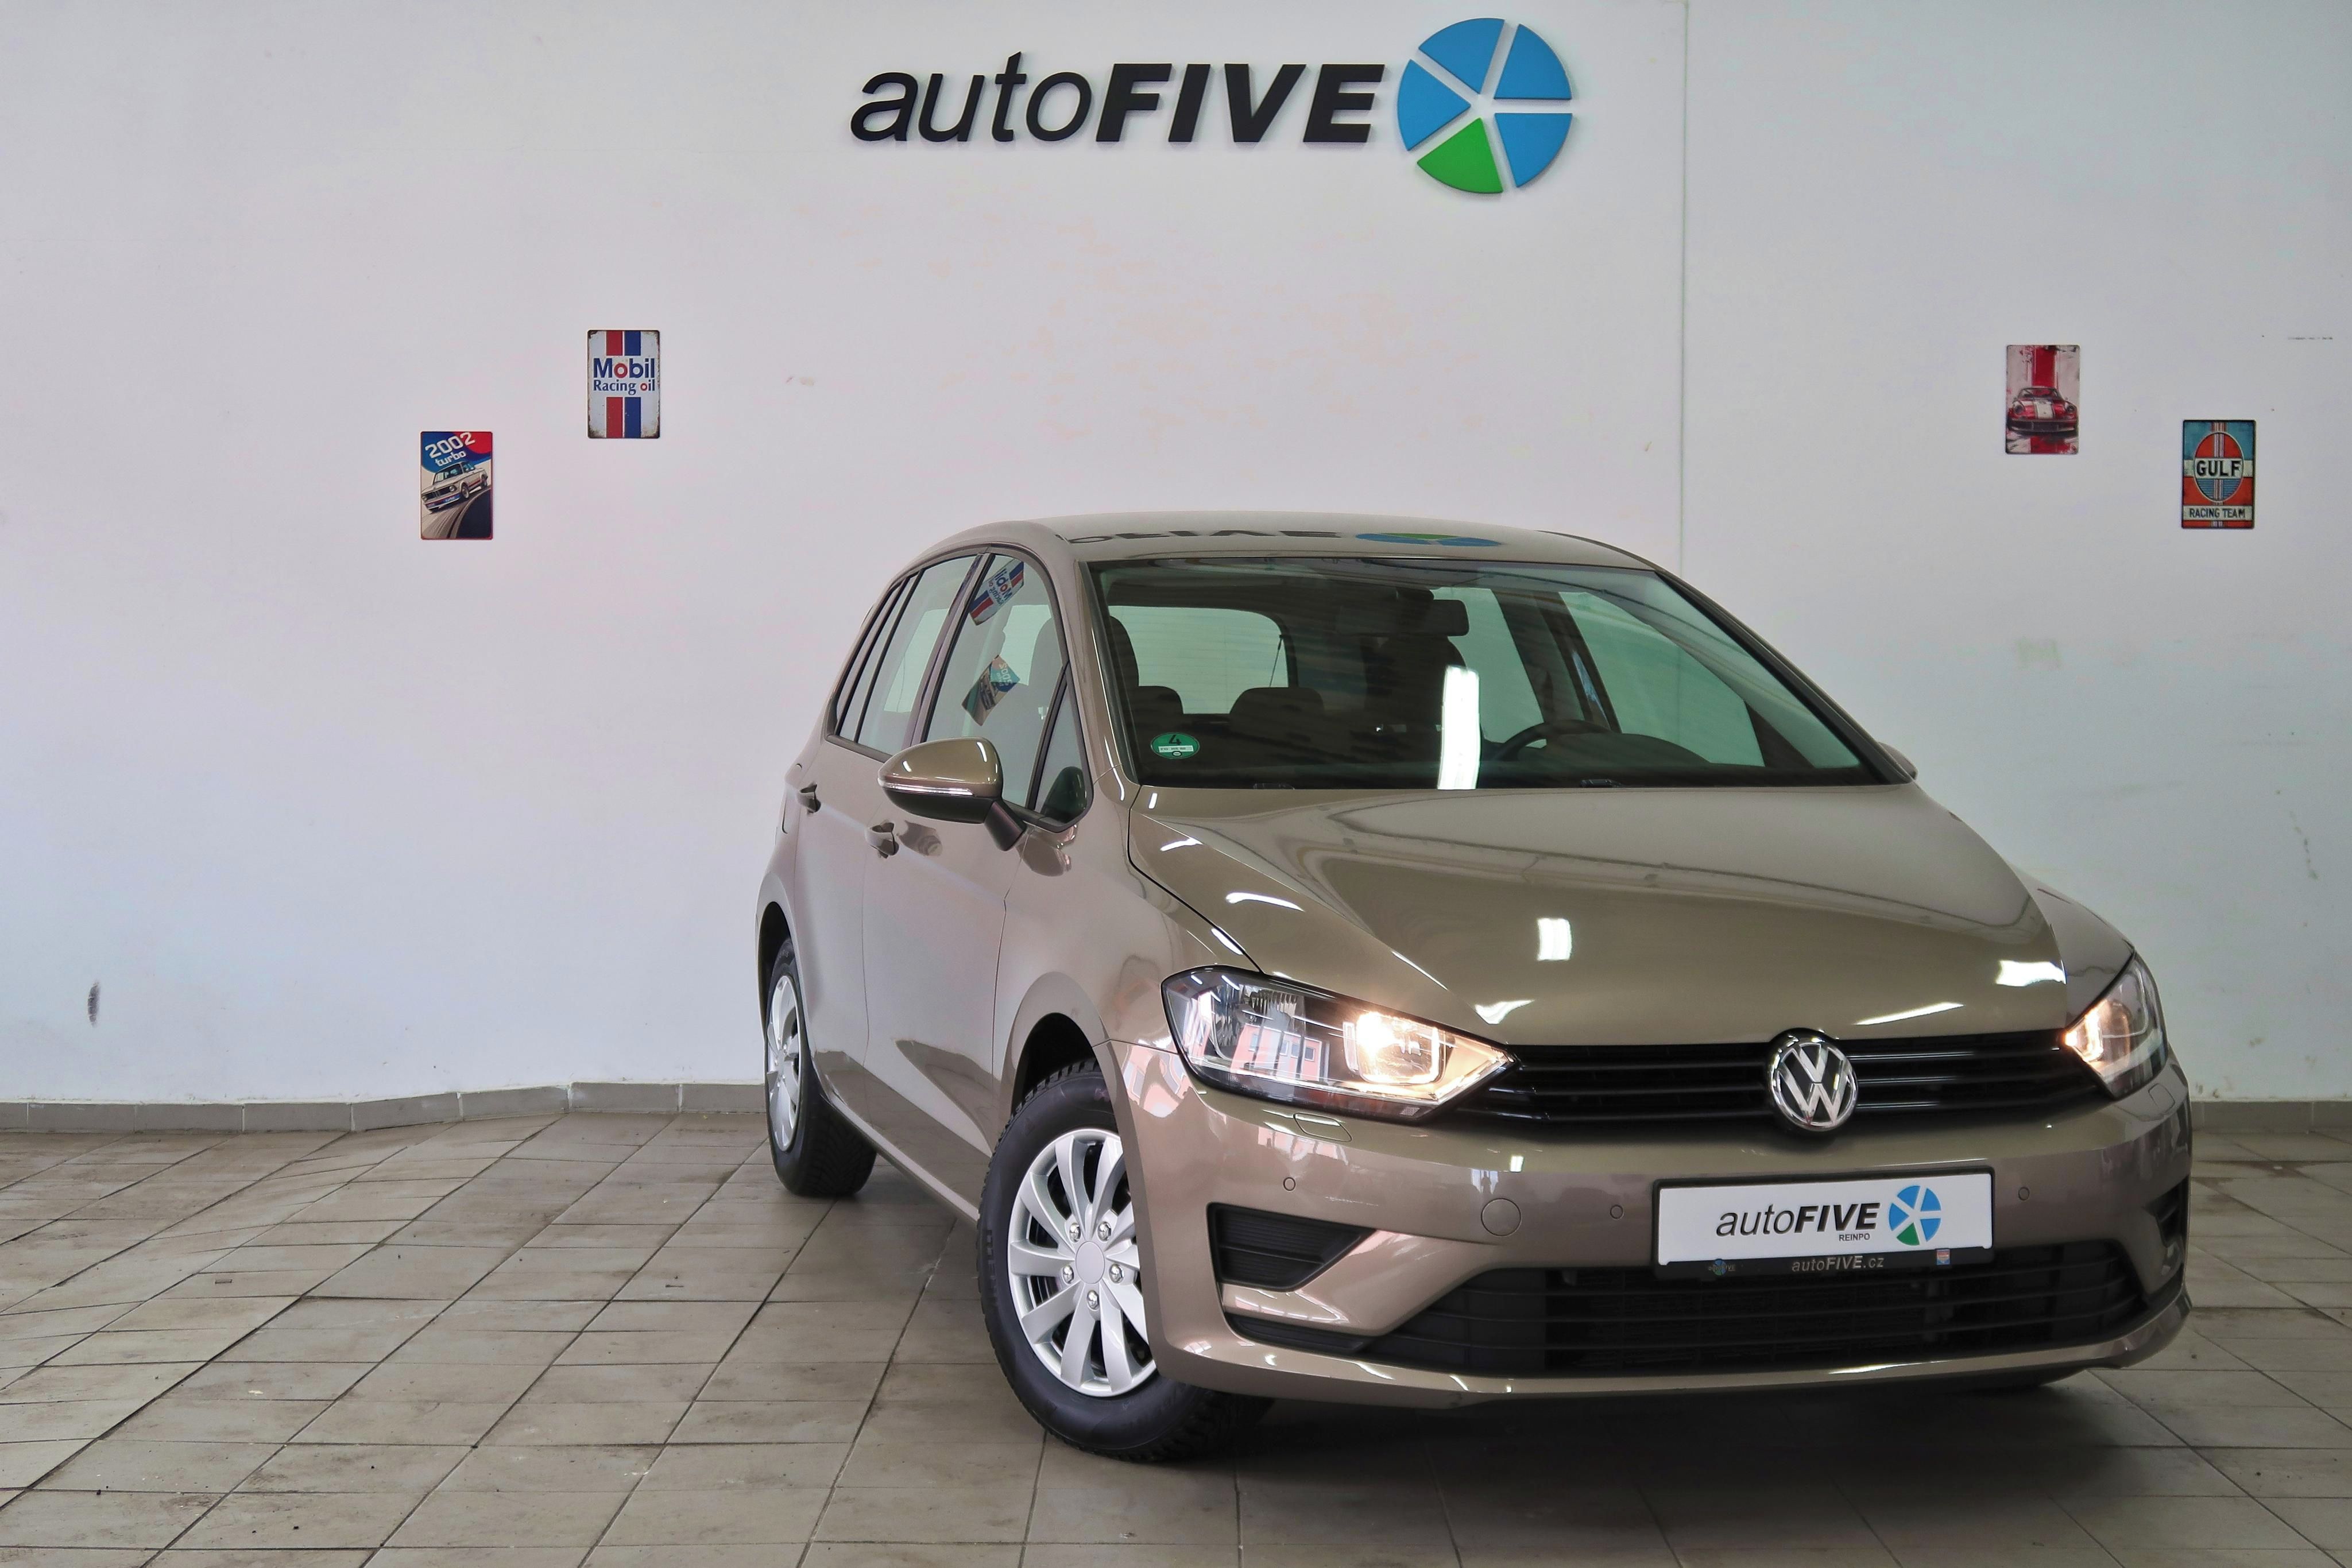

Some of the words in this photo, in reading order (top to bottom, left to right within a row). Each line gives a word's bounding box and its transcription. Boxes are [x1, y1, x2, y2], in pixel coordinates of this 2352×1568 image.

[850, 51, 1385, 143] autoFIVE
[593, 358, 655, 379] Mobil
[593, 380, 636, 396] Racing
[640, 379, 655, 392] oil
[425, 432, 475, 459] 2002
[435, 450, 467, 467] turbo
[2196, 460, 2242, 477] GULF
[2189, 508, 2220, 518] RACING
[2222, 508, 2246, 518] TEAM
[1169, 734, 1182, 746] 4
[1716, 1203, 1881, 1237] autoFIVE
[1839, 1233, 1870, 1242] REINPO
[1792, 1255, 1885, 1272] autoFIVE.cz
